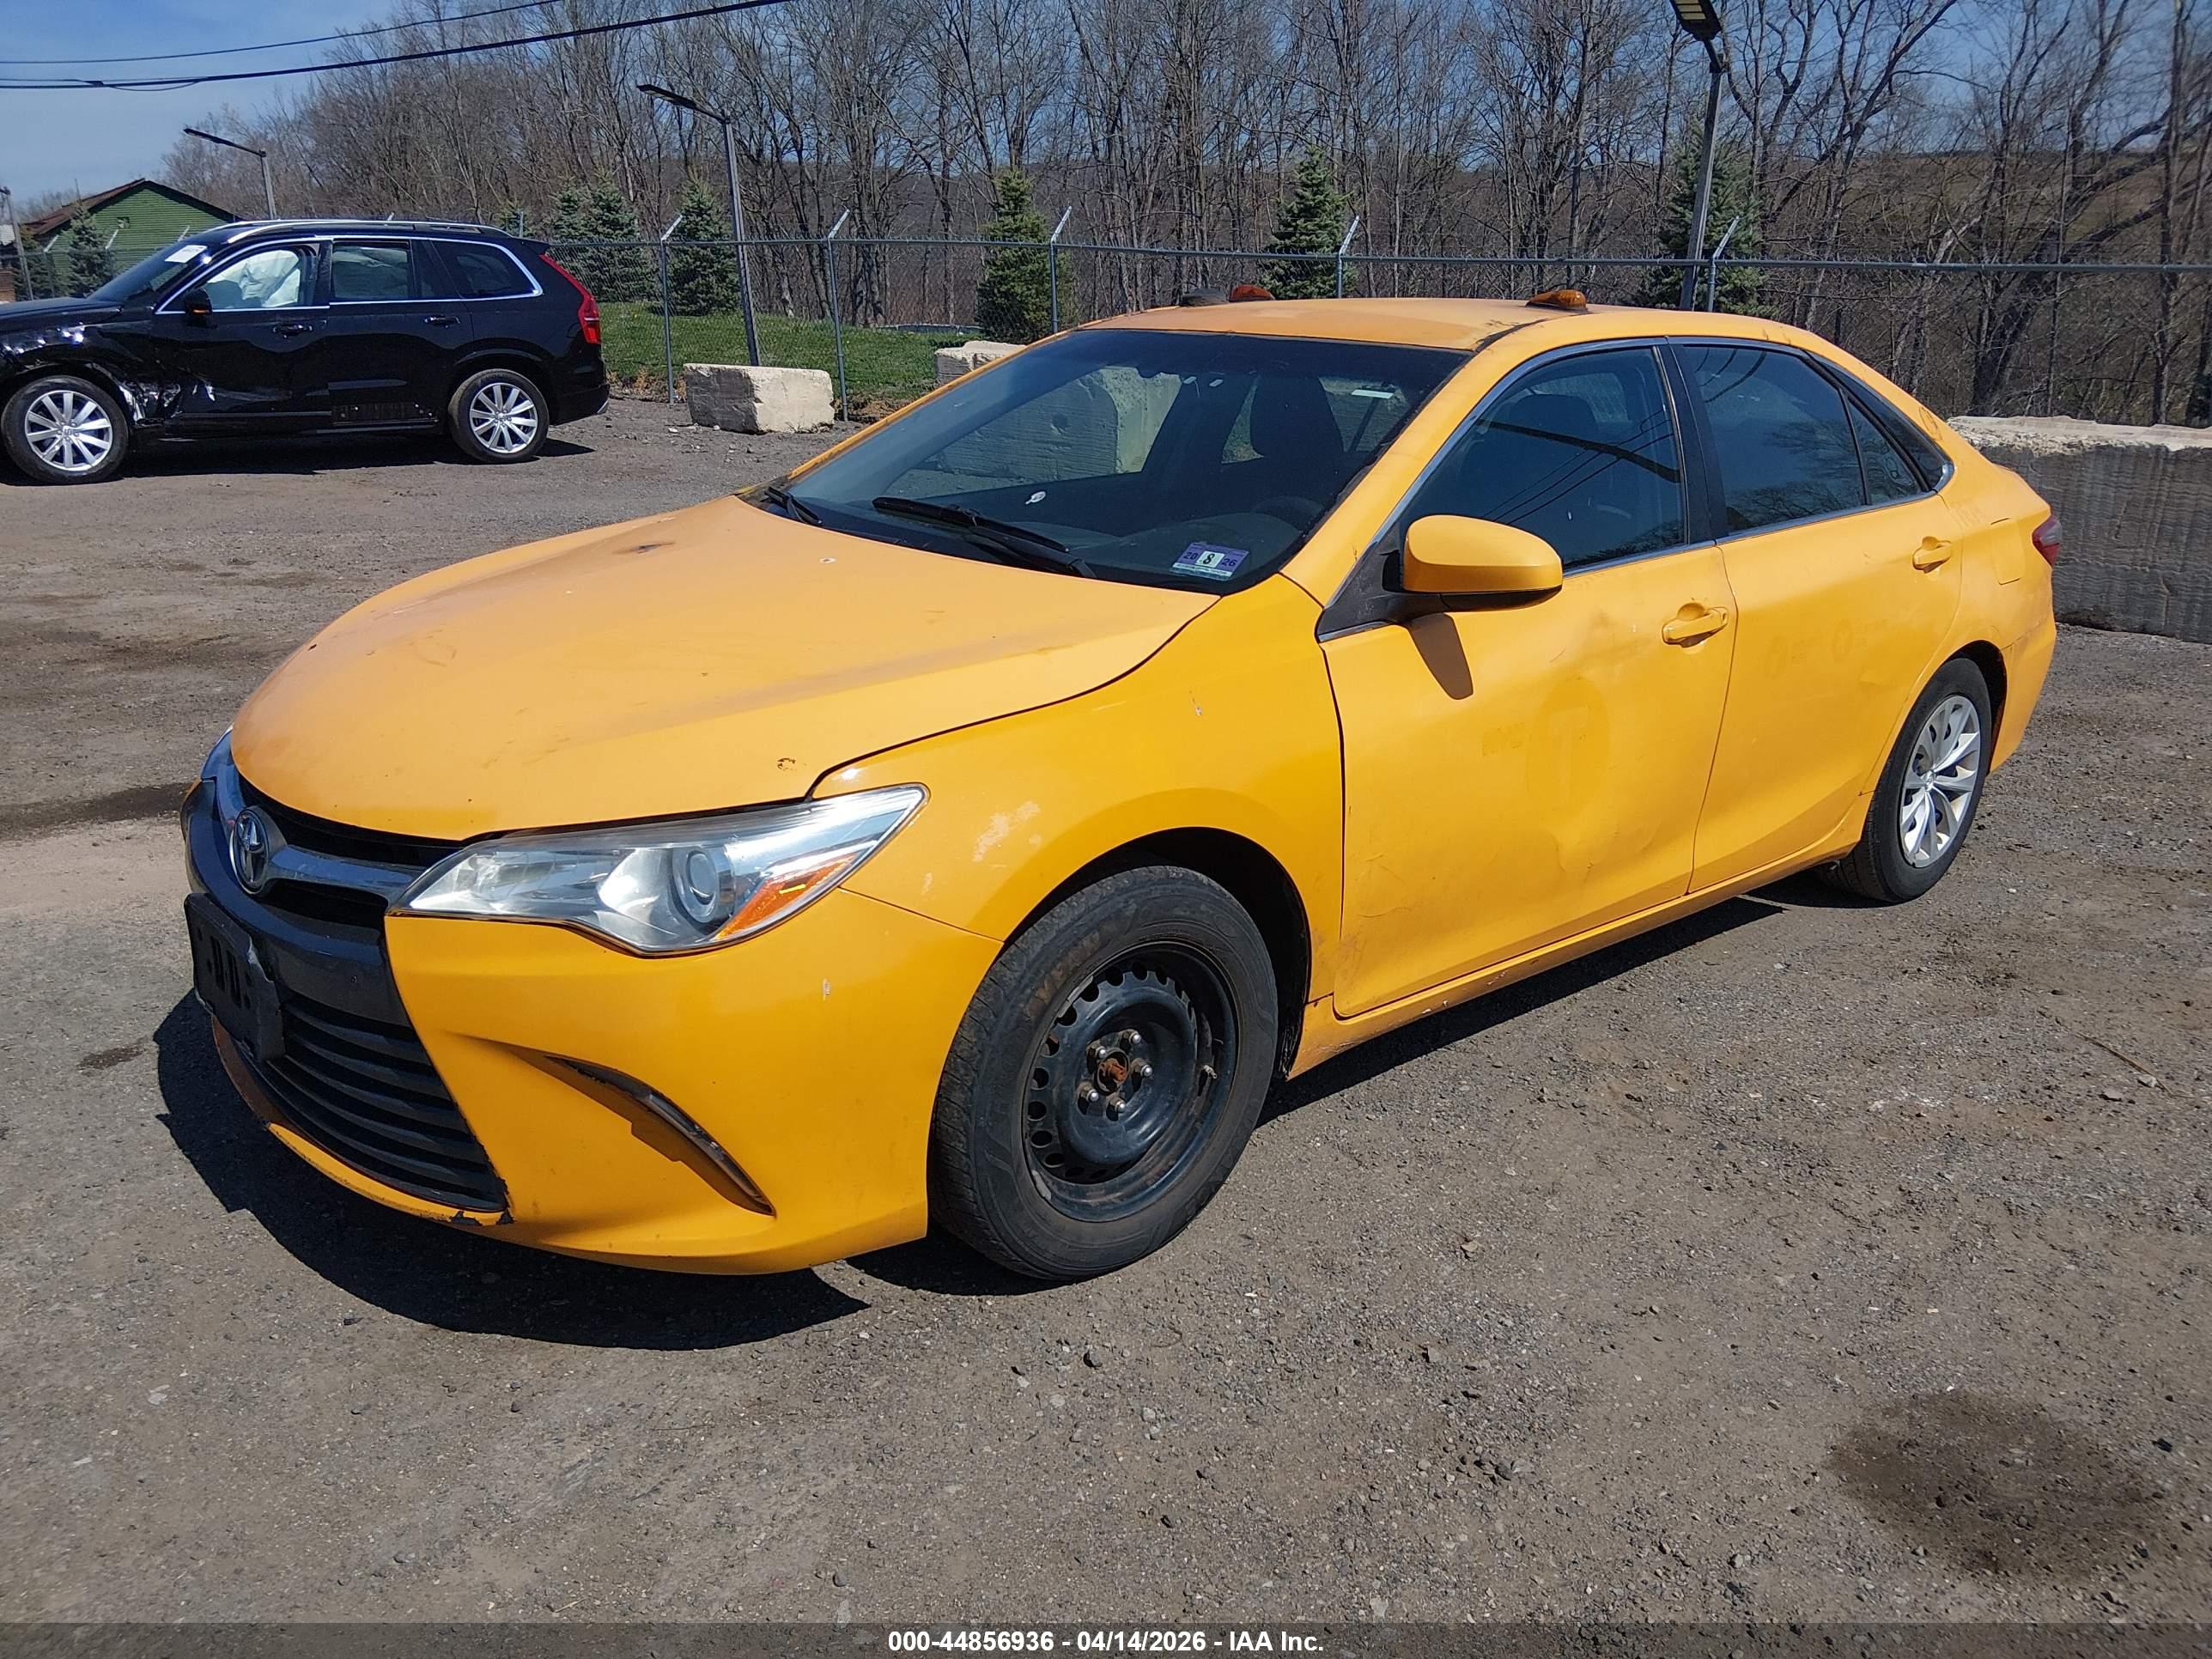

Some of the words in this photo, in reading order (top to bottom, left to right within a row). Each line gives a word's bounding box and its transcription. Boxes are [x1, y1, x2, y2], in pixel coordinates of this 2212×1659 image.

[1183, 551, 1199, 561] 20
[1203, 553, 1216, 565] 8
[1221, 558, 1237, 567] 26
